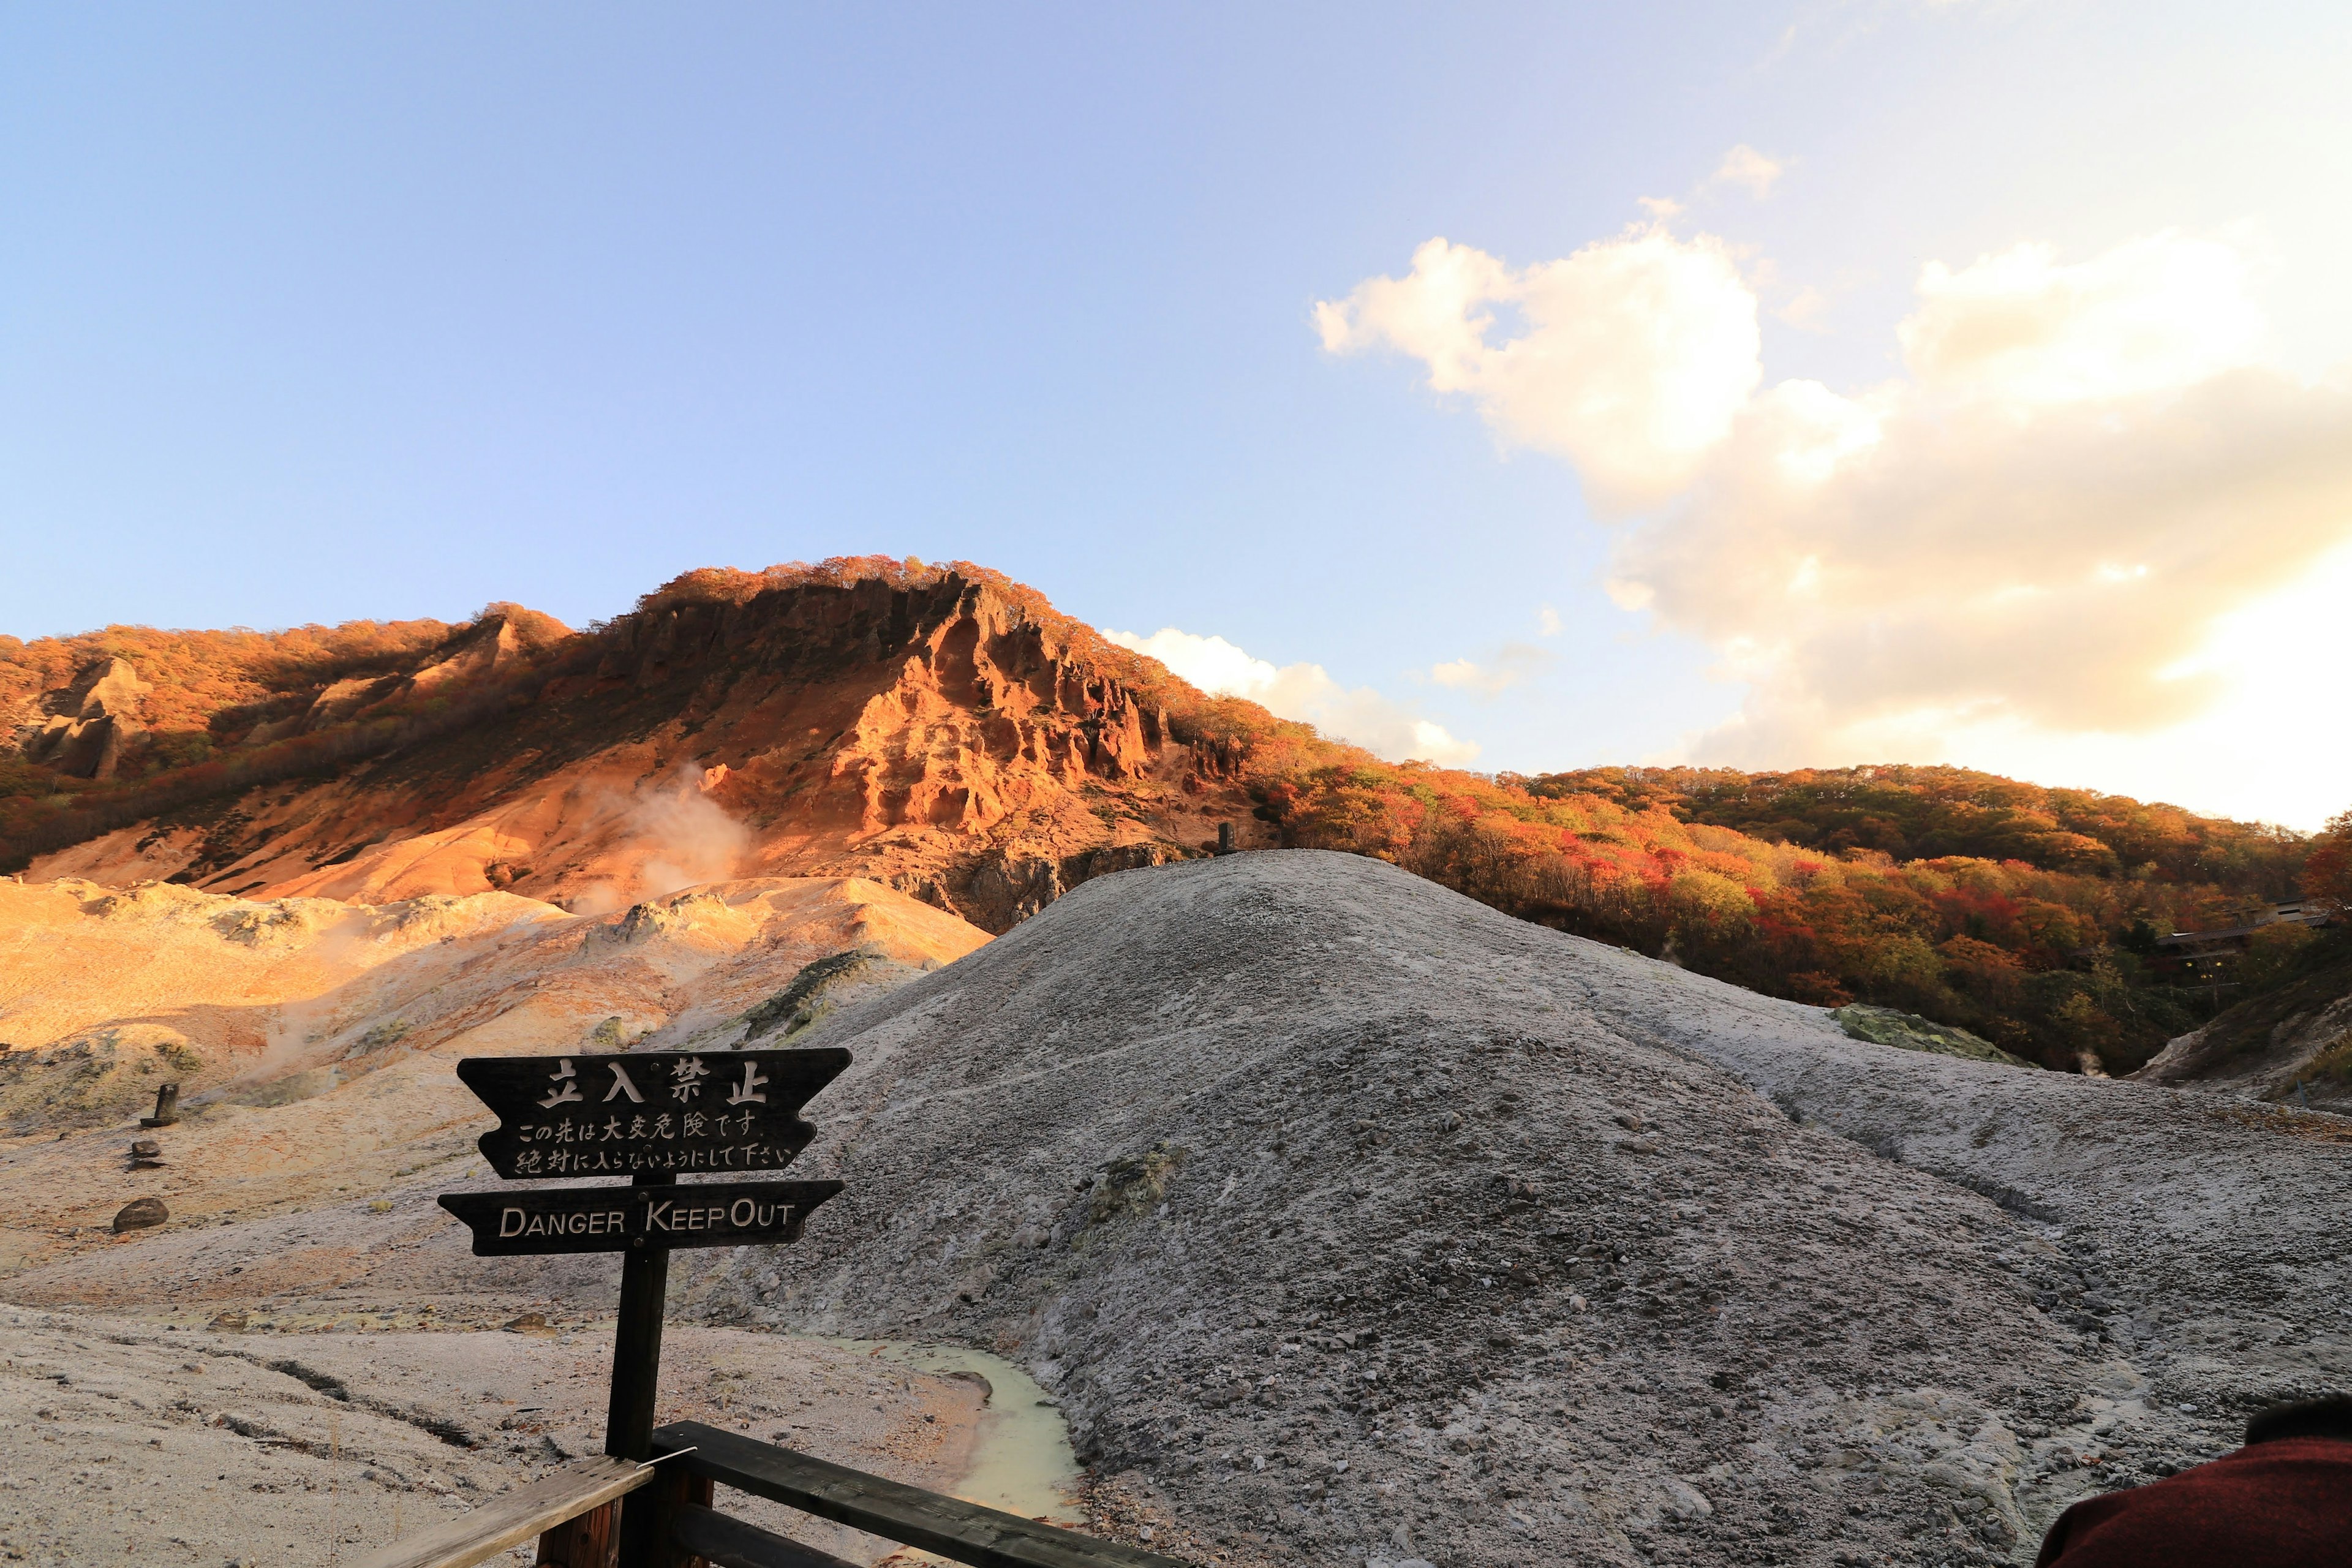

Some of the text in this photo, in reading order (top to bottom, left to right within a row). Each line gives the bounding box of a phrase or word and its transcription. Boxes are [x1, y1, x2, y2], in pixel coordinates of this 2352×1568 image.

[537, 1055, 769, 1109] 立入禁止
[514, 1142, 792, 1174] 絶対に入らないようにして下さい
[499, 1207, 625, 1238] DANGER
